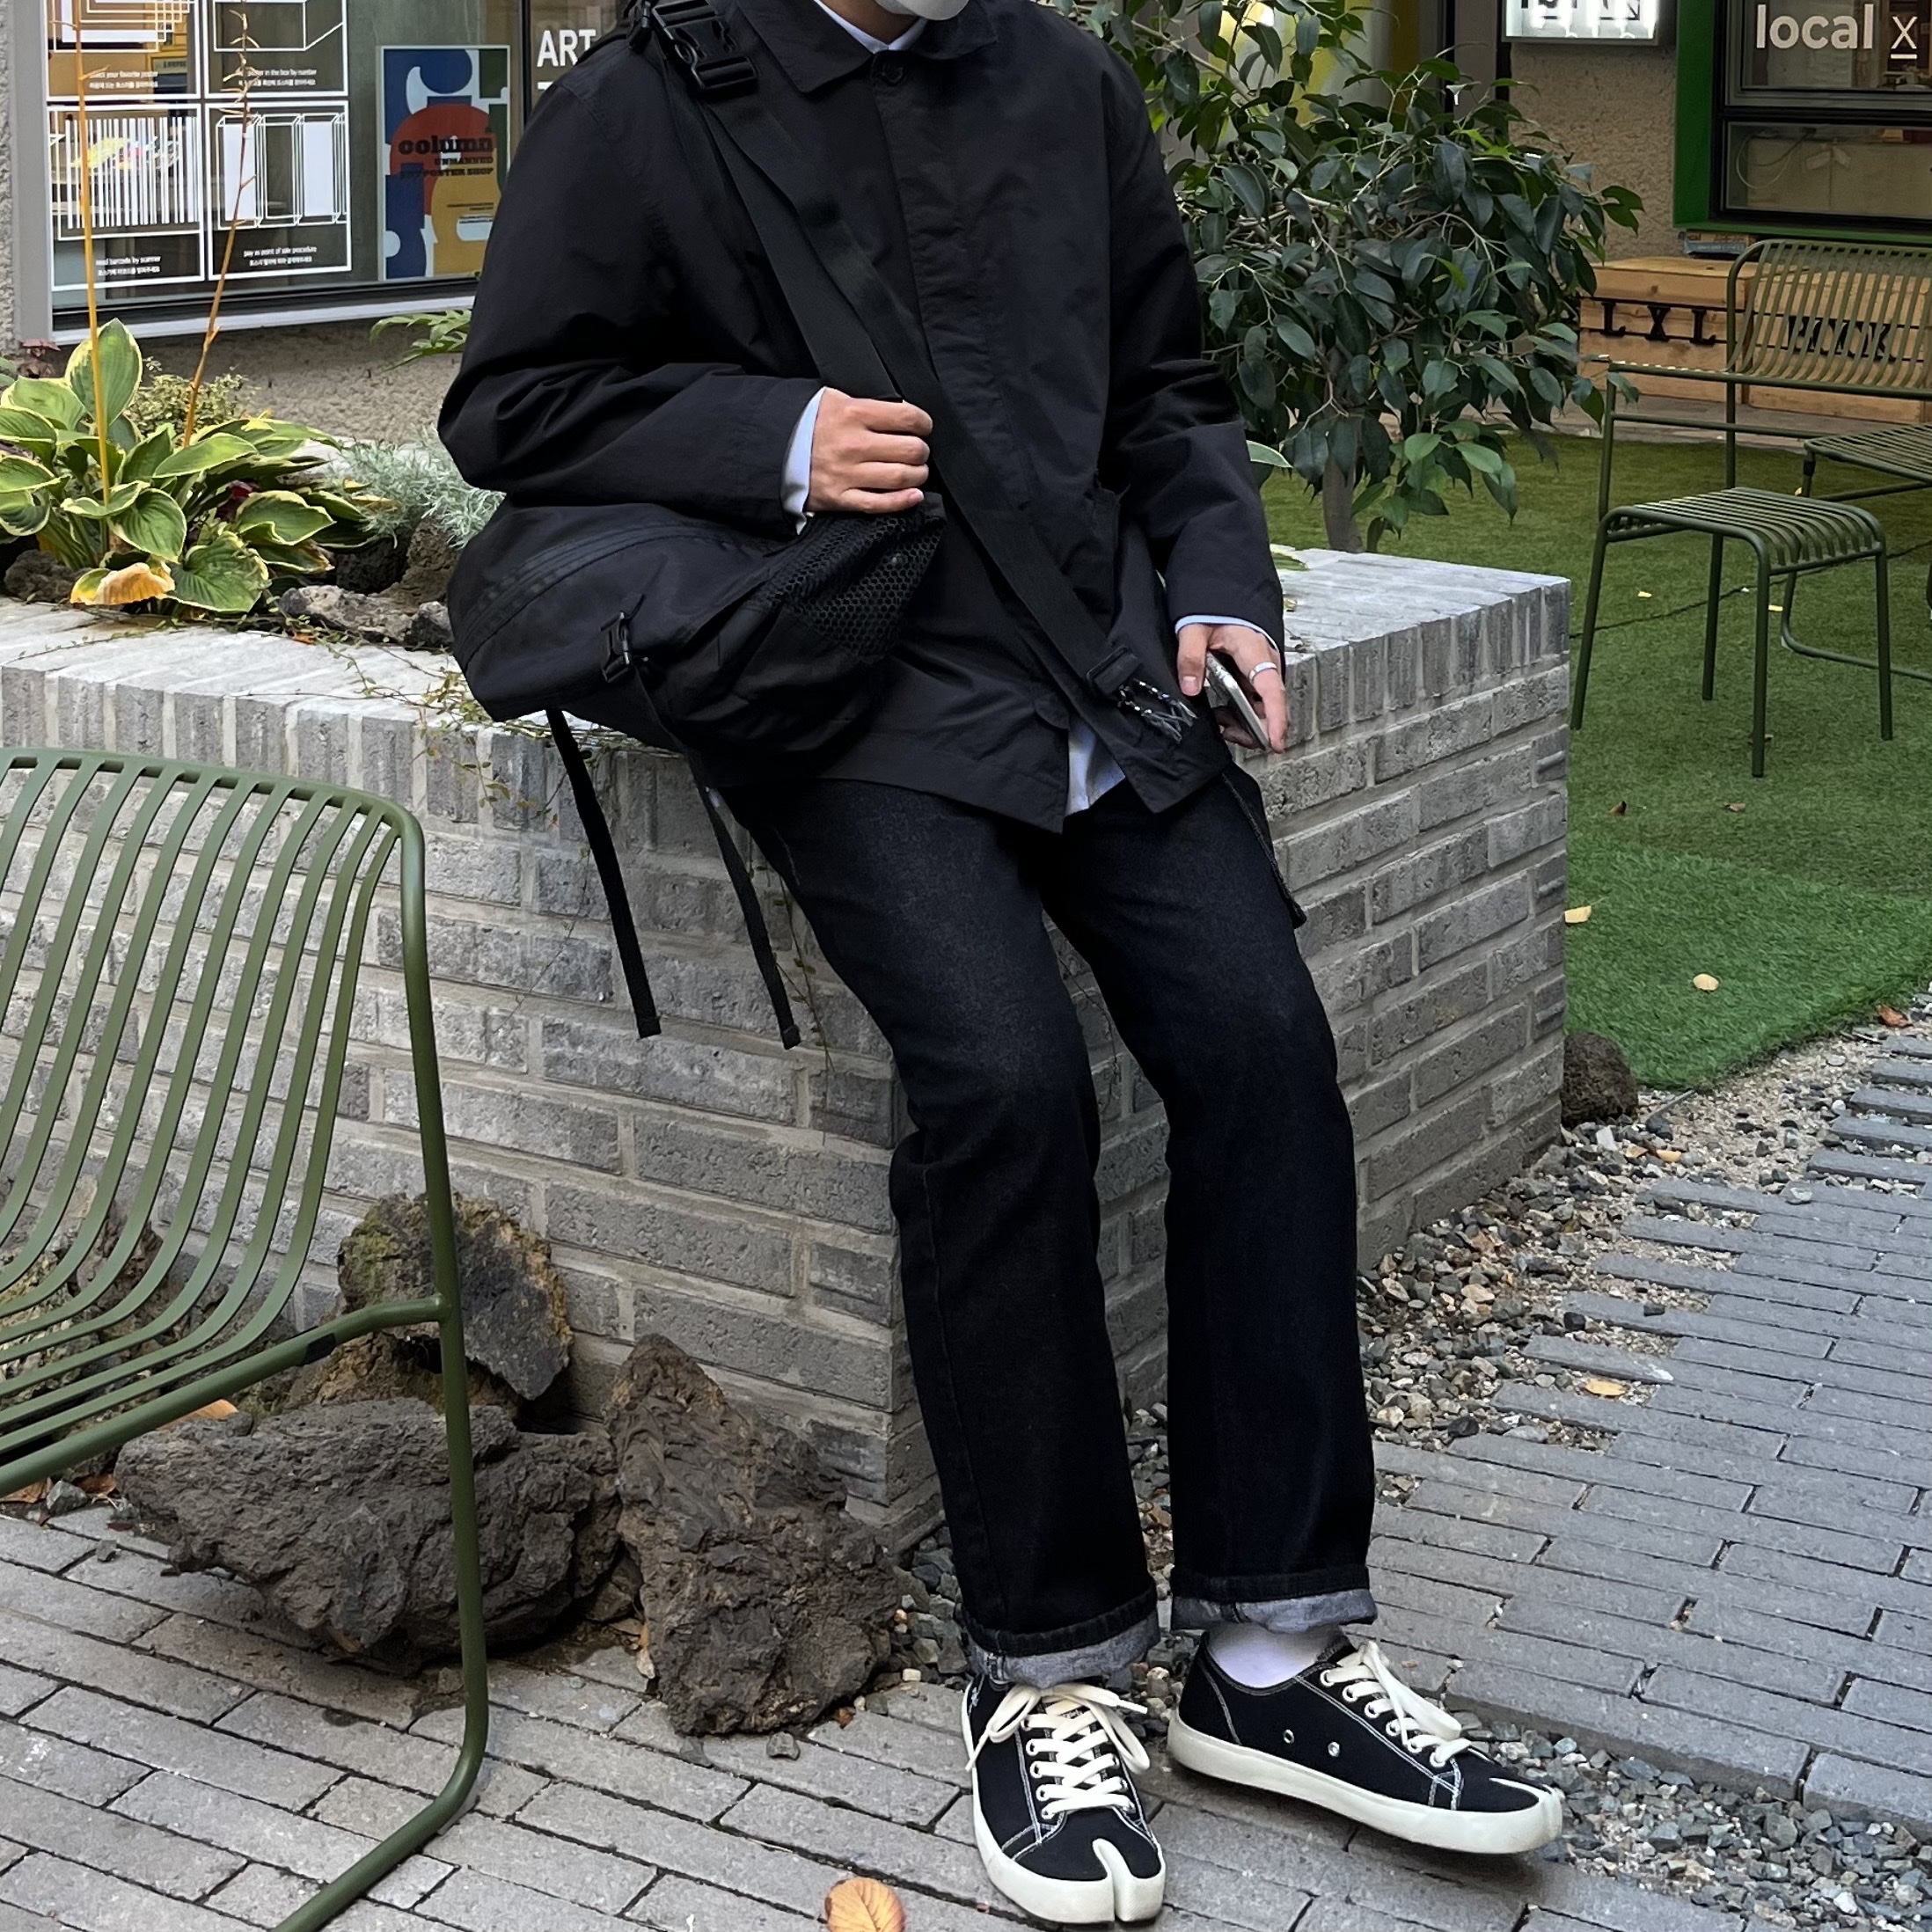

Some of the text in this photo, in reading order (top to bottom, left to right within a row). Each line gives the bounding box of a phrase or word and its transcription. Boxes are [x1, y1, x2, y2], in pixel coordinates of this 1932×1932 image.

[1757, 4, 1874, 49] local
[537, 29, 596, 67] ART
[399, 135, 493, 155] column
[1599, 300, 1716, 347] LXL
